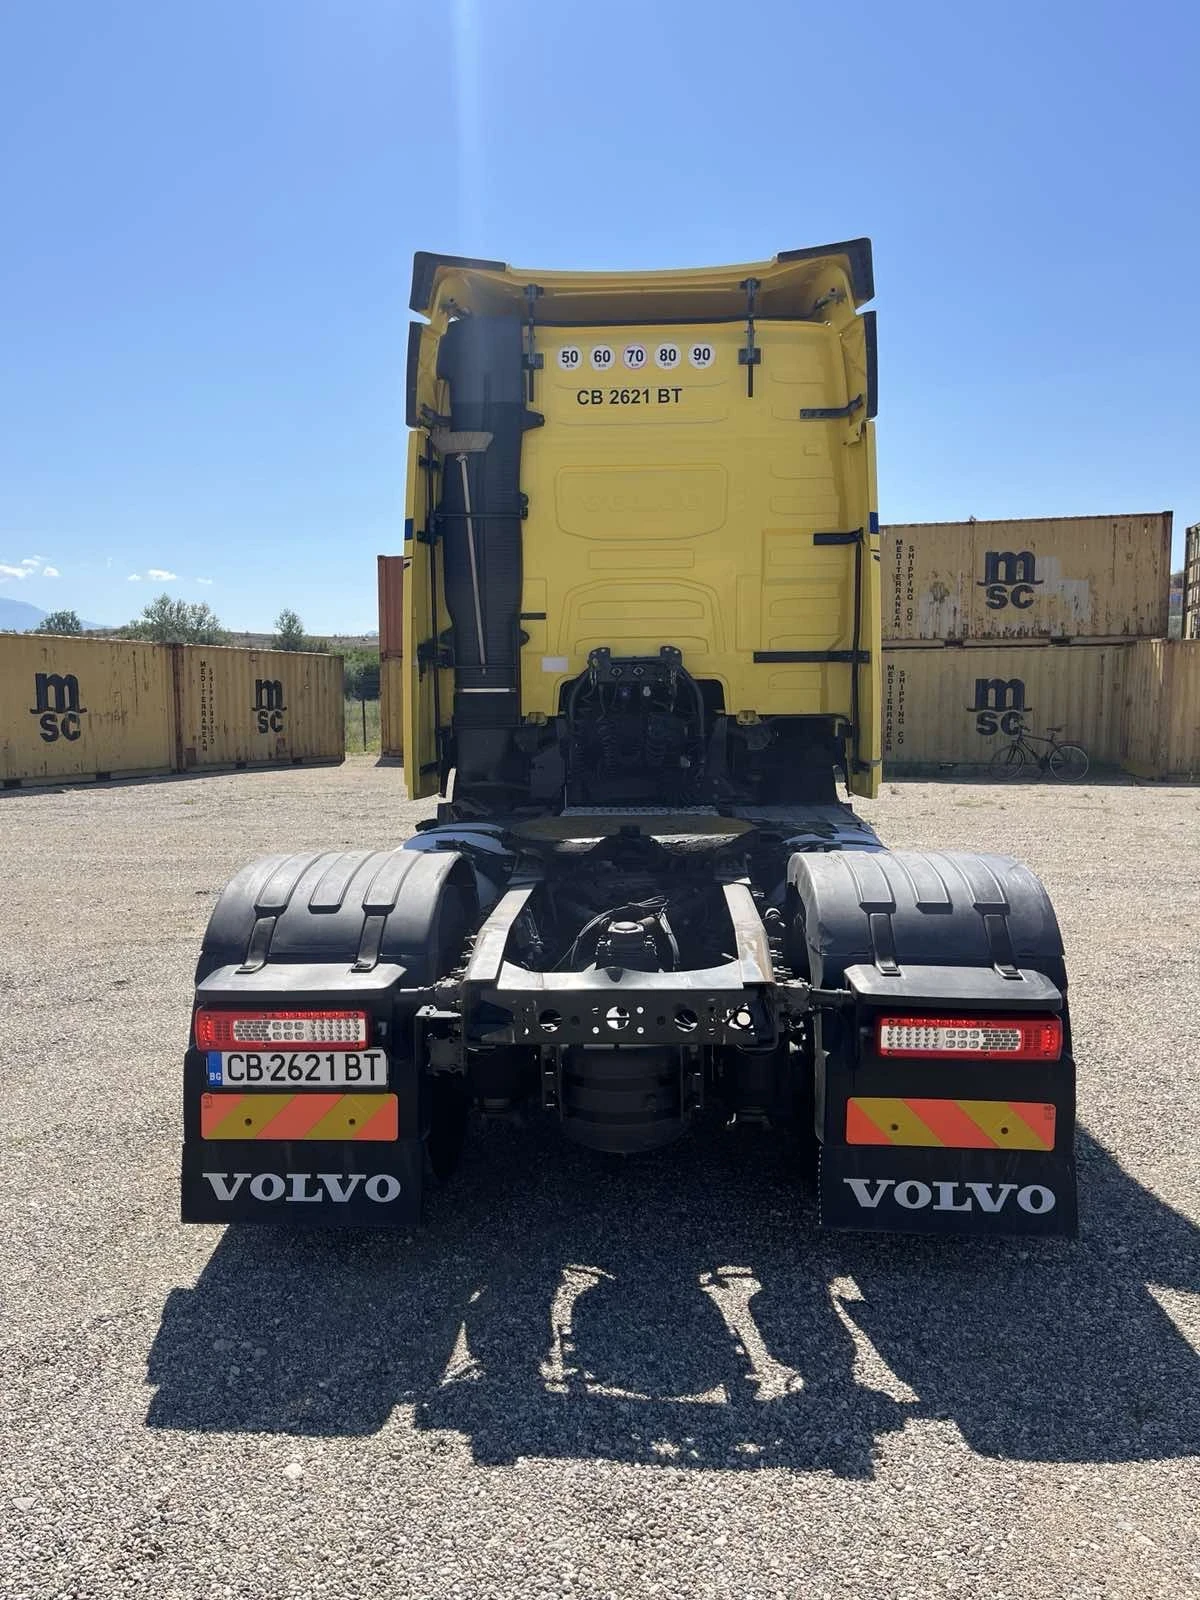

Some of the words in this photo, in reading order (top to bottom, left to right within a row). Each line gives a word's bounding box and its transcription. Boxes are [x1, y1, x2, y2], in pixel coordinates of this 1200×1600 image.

[562, 350, 579, 364] 50
[594, 350, 611, 363] 60
[626, 350, 644, 362] 70
[660, 348, 677, 362] 80
[693, 348, 710, 361] 90
[576, 390, 603, 405] CB
[610, 388, 650, 404] 2621
[658, 388, 682, 404] BT
[894, 540, 903, 628] MEDITERRANEAN
[886, 664, 894, 752] MEDITERRANEAN
[210, 1072, 221, 1081] BG
[202, 1172, 401, 1204] VOLVO
[843, 1178, 1056, 1214] VOLVO
